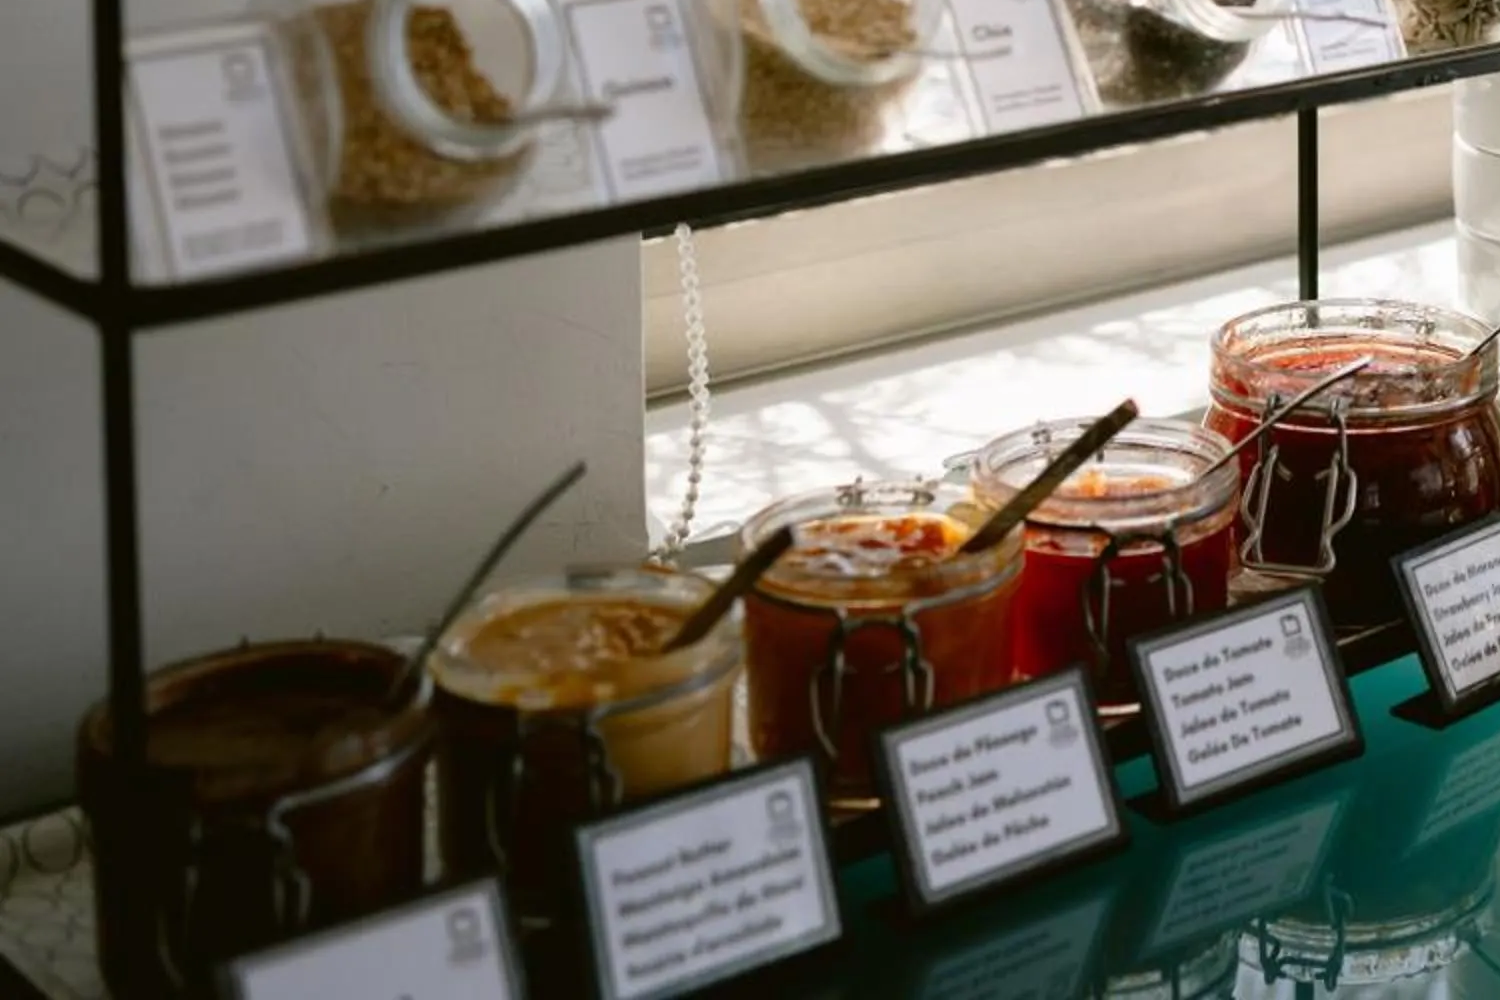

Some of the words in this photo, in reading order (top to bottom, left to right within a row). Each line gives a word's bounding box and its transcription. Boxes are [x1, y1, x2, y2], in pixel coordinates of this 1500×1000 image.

[1453, 569, 1466, 584] de
[1433, 591, 1490, 621] Strawberry
[1472, 618, 1486, 632] de
[1484, 639, 1498, 657] de
[1163, 663, 1199, 684] Doce
[1202, 654, 1220, 670] de
[1221, 637, 1273, 662] Tomate
[1171, 684, 1224, 709] Tomato
[1226, 672, 1255, 691] Jam
[1180, 716, 1217, 738] Jalea
[1220, 706, 1238, 723] de
[1230, 733, 1249, 749] De
[1251, 714, 1302, 741] Tomate
[952, 744, 972, 762] de
[967, 769, 998, 790] Jam
[970, 803, 990, 820] de
[982, 831, 1001, 848] de
